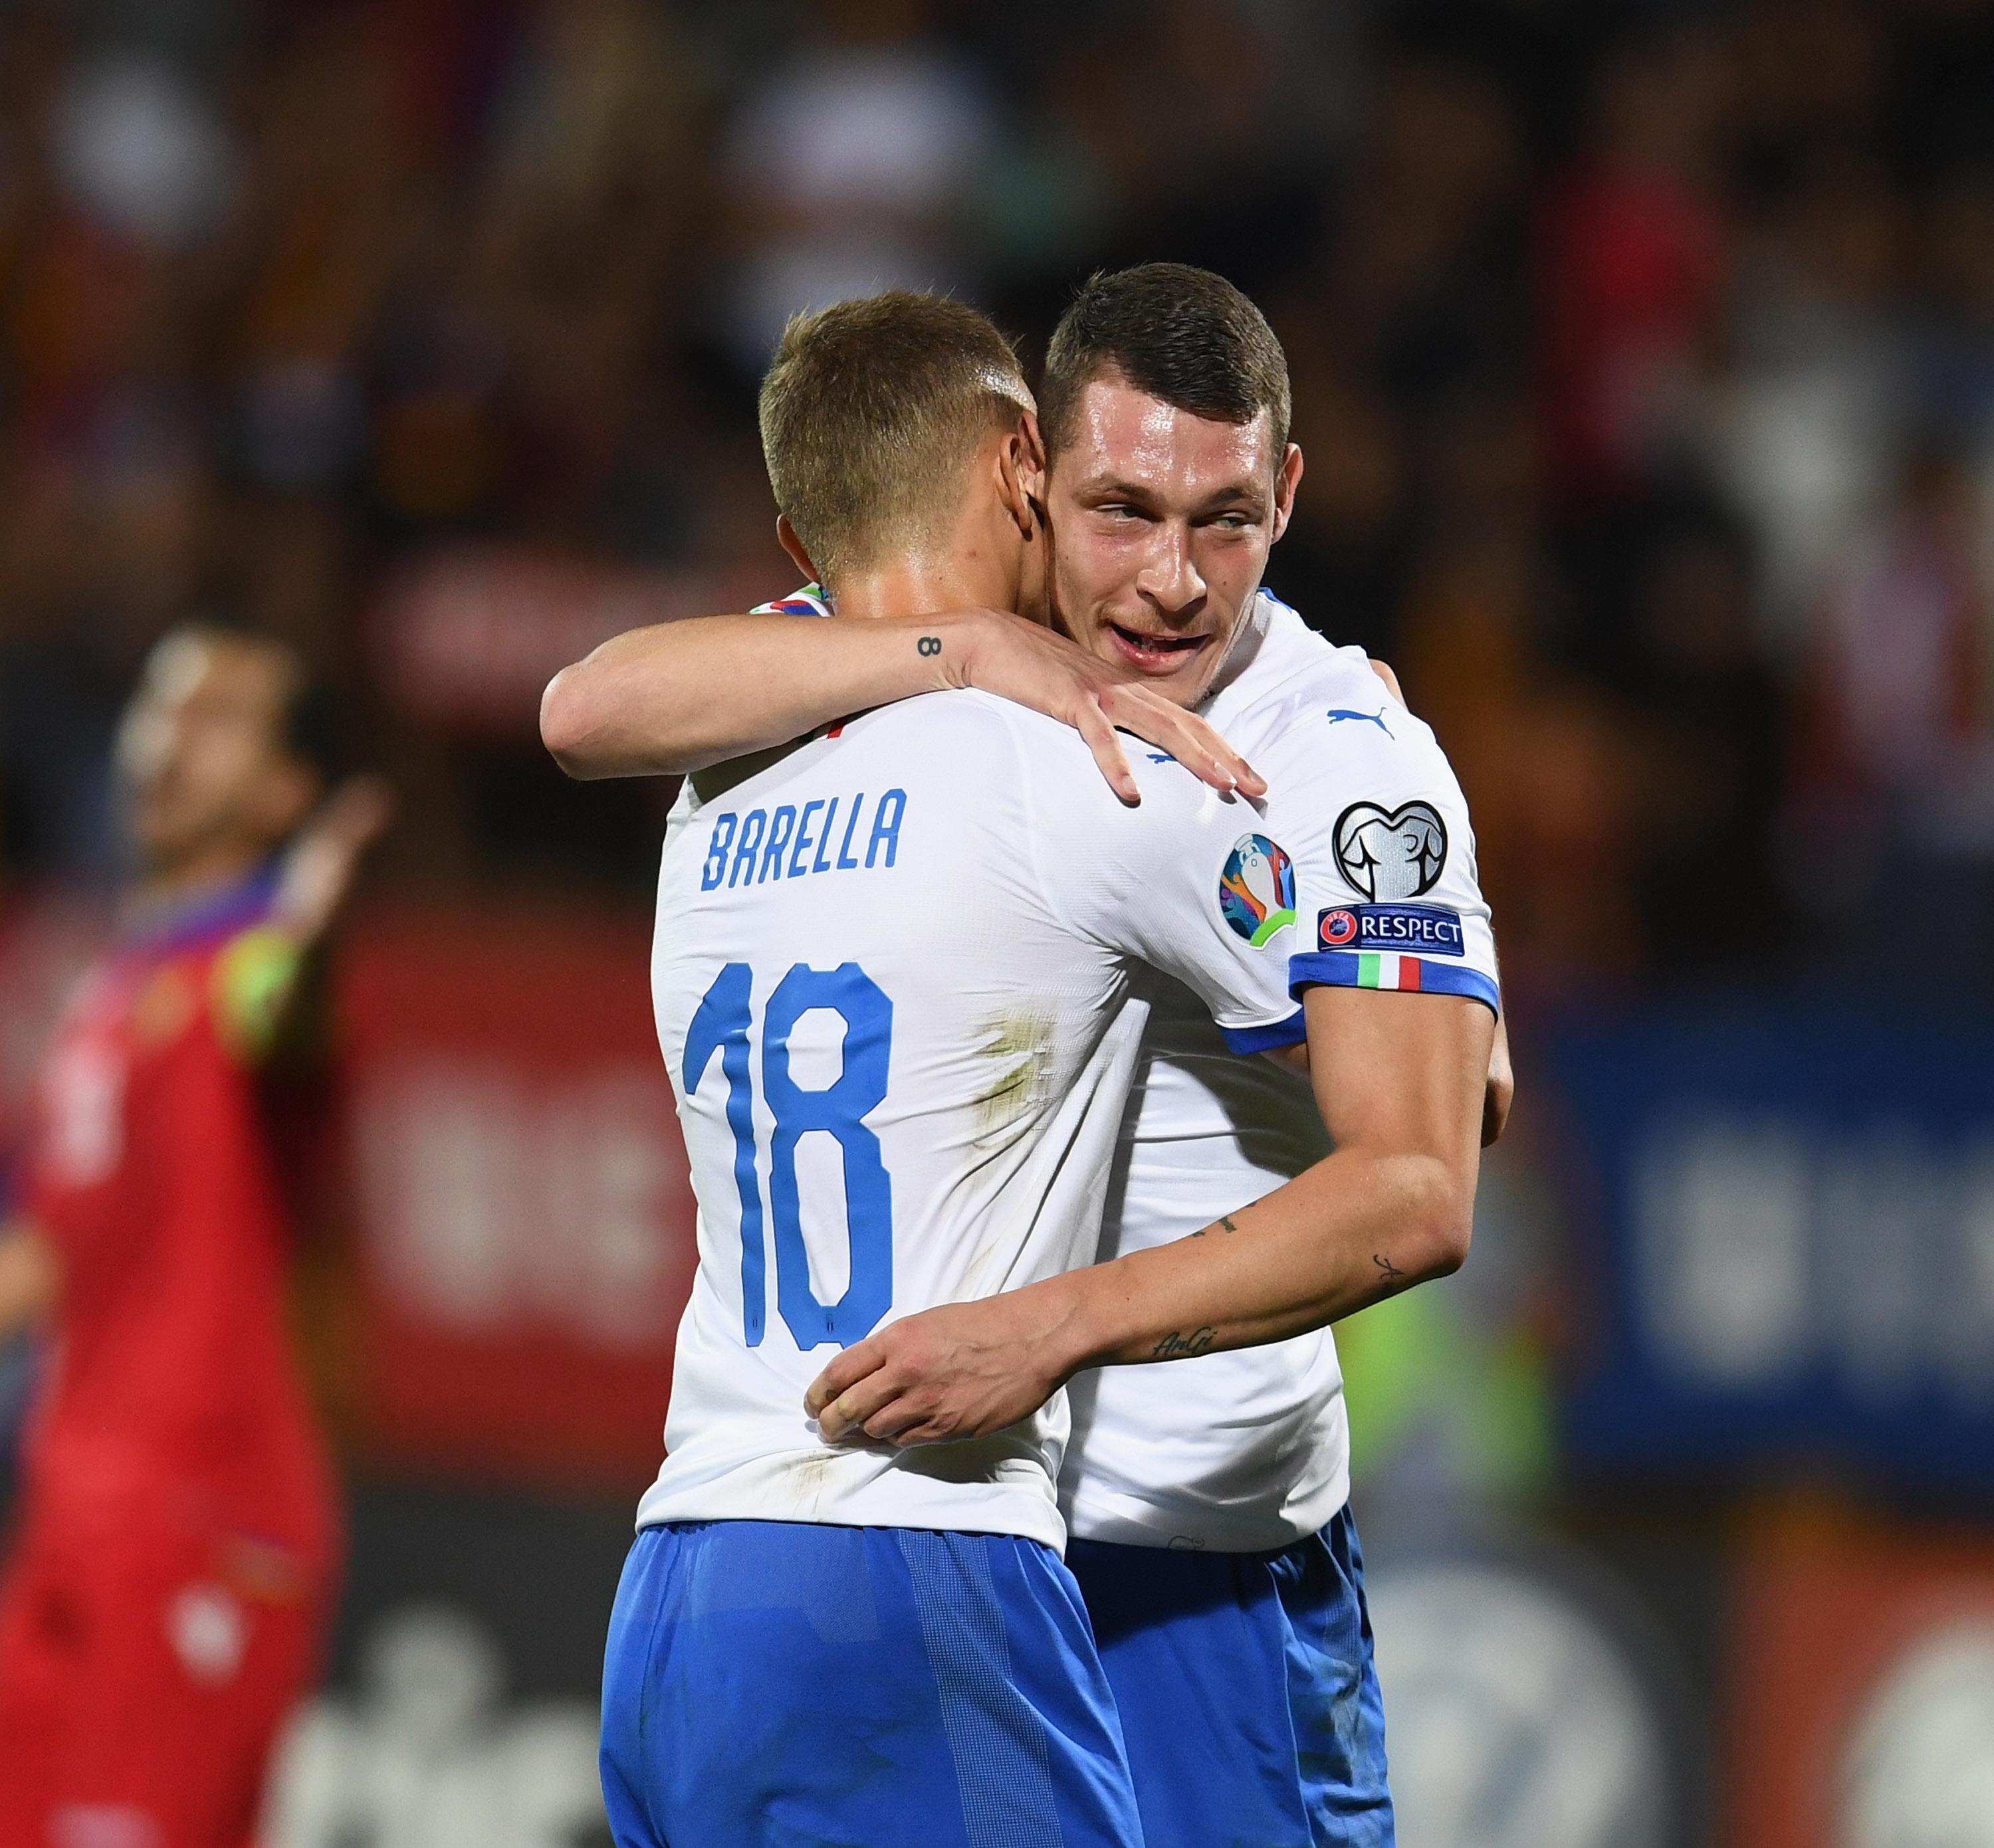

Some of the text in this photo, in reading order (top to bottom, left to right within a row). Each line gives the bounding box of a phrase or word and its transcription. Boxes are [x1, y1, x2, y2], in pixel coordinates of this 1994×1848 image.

[918, 637, 941, 657] 8
[701, 789, 907, 891] BARELLA
[1327, 912, 1349, 922] UEFA
[1362, 917, 1460, 942] RESPECT
[683, 962, 893, 1351] 18
